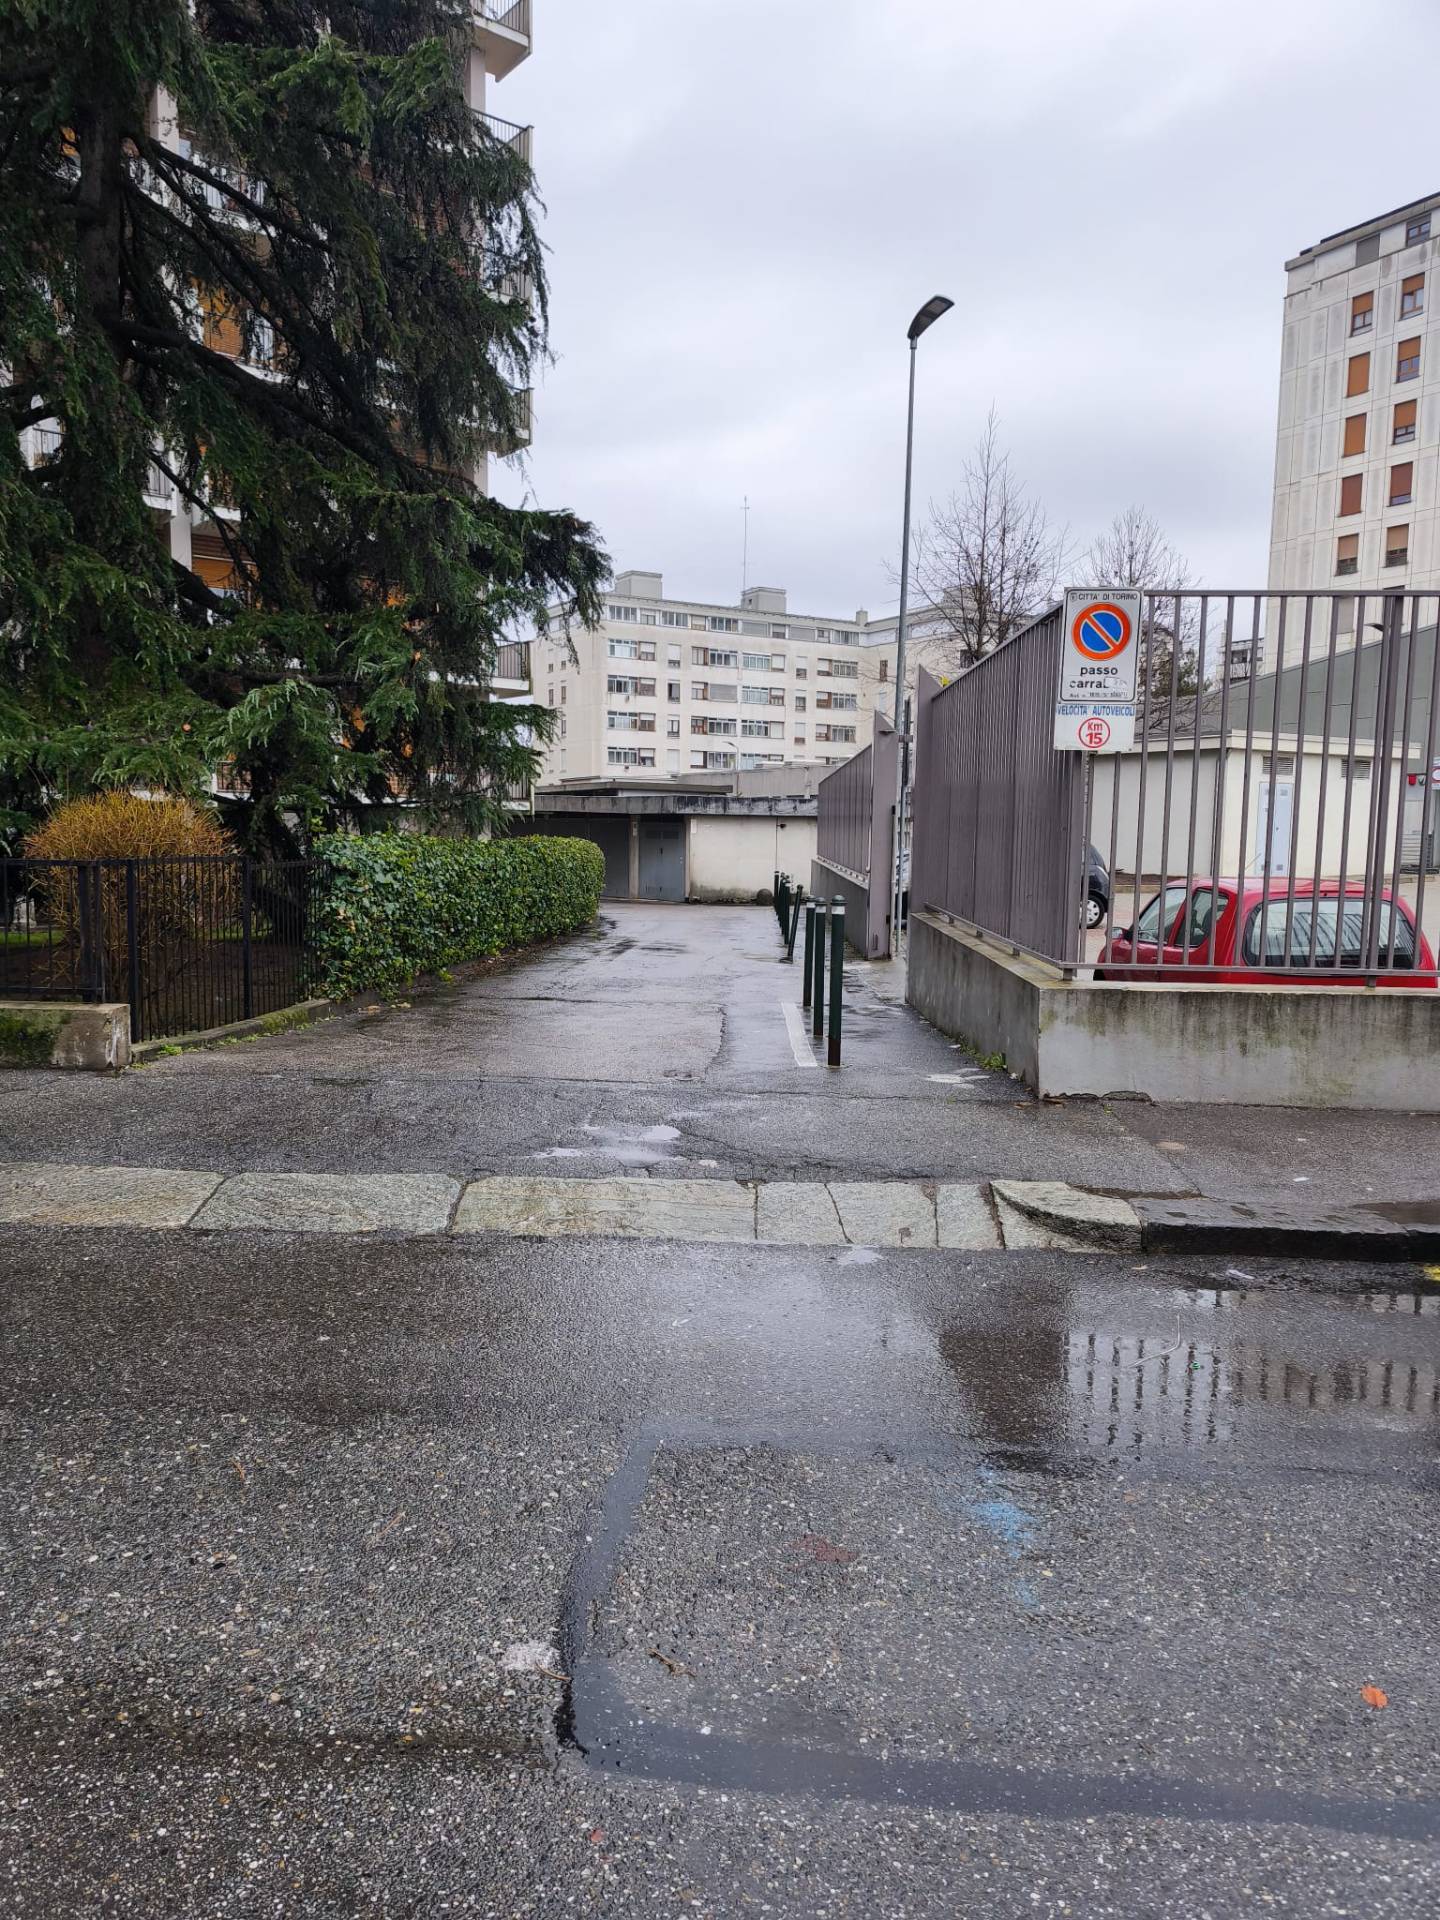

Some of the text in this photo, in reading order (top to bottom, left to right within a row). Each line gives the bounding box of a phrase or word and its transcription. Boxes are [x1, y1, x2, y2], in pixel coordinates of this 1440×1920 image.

[1102, 593, 1110, 601] DI
[1112, 593, 1138, 601] TORINO
[1080, 667, 1118, 676] passo
[1092, 705, 1135, 717] AUTOVEICOLI
[1087, 722, 1103, 731] Km
[1086, 732, 1103, 745] 15
